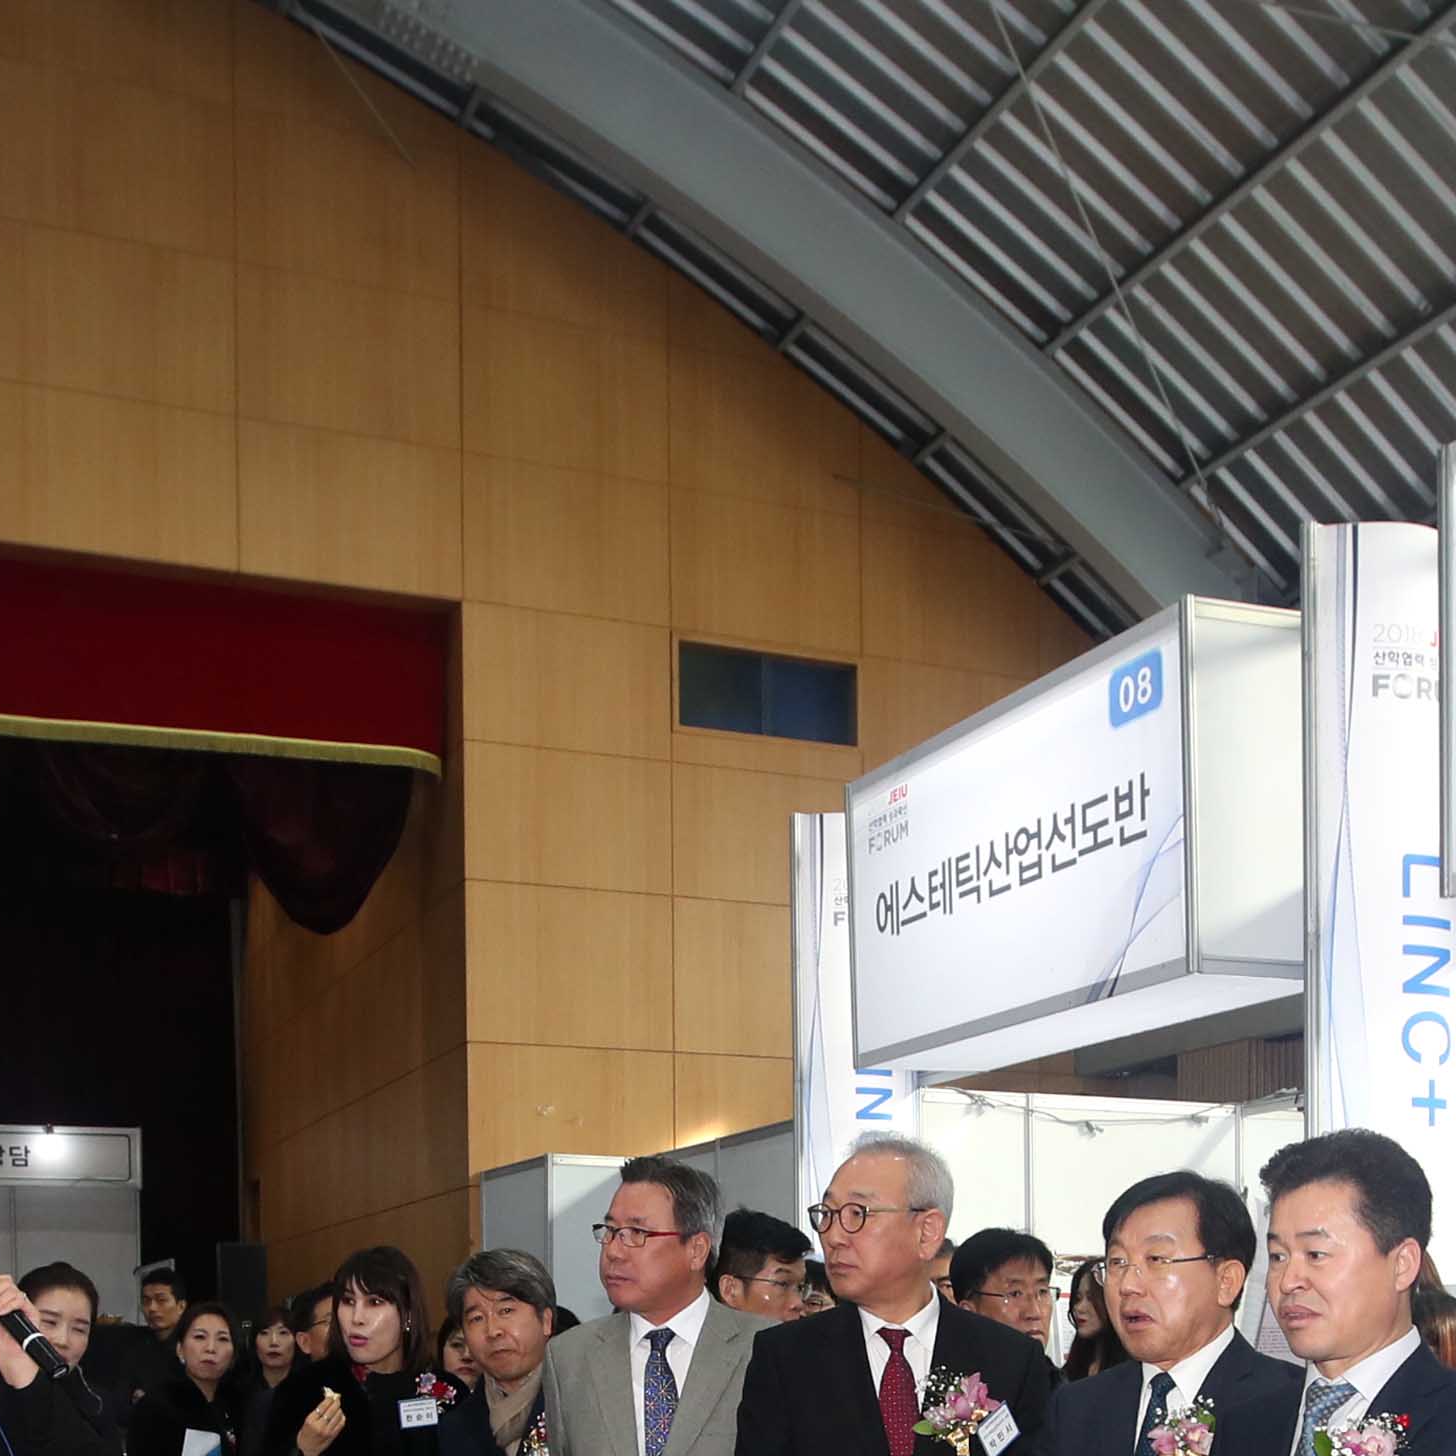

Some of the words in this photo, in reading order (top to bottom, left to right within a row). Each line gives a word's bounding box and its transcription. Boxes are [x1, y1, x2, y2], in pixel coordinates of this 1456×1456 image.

[1119, 665, 1153, 712] 08
[888, 783, 908, 805] JEIU
[875, 771, 1151, 937] 에스테틱산업선도반
